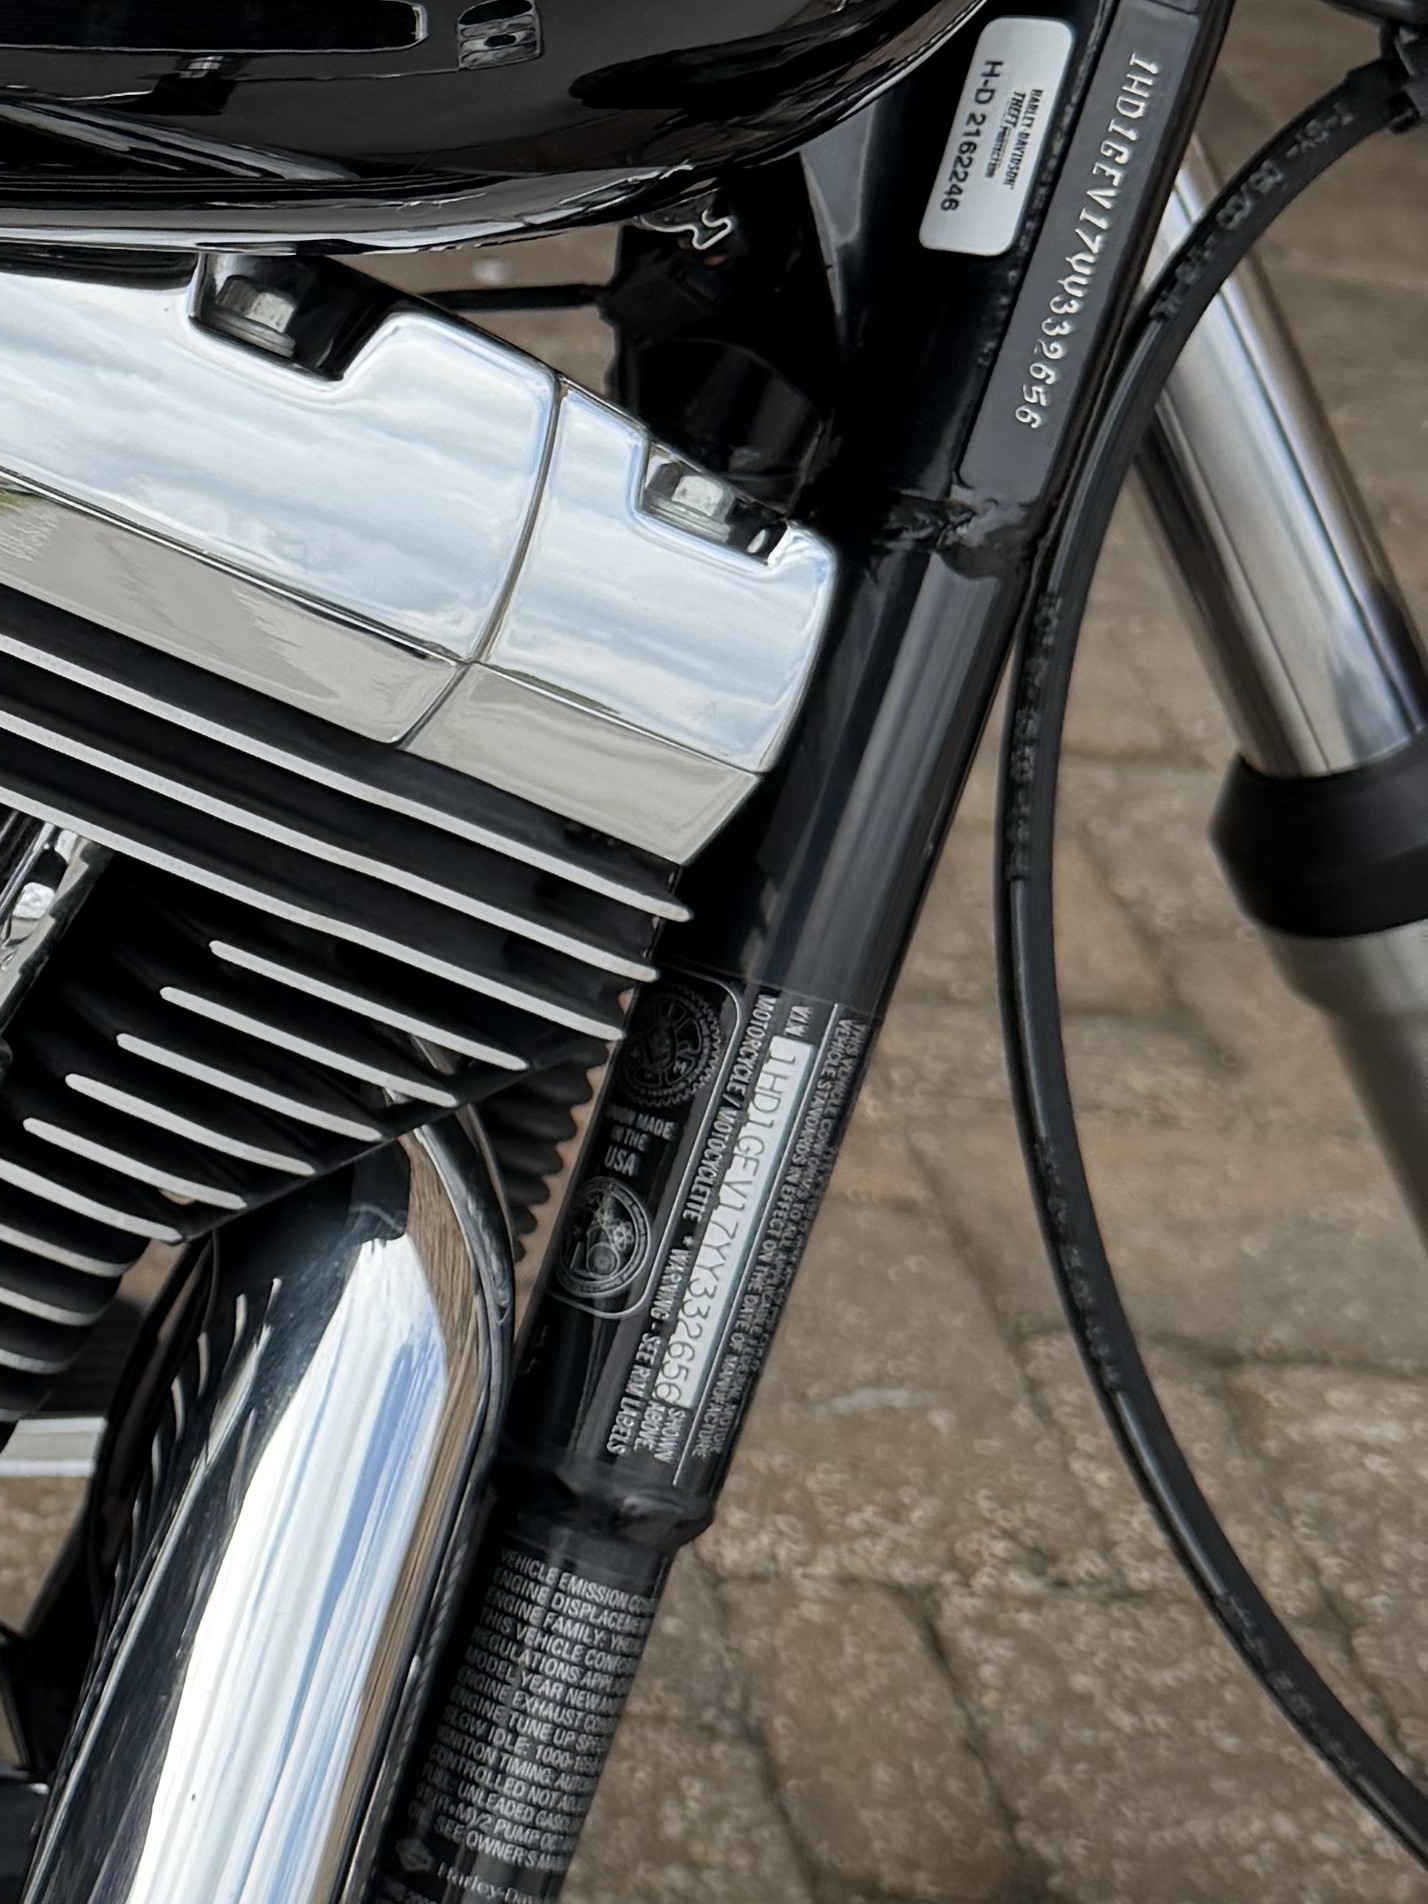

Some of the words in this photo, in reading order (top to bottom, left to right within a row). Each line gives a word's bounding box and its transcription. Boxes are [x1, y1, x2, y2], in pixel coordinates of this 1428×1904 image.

[972, 55, 1003, 108] H-D
[940, 108, 985, 215] 2162246
[784, 1003, 814, 1039] VIN
[728, 991, 778, 1098] MOTORCYCLE
[819, 1016, 854, 1078] VEHICLE
[604, 1145, 640, 1176] USA
[649, 1046, 799, 1406] 1HD1GEV17YY332656
[647, 1245, 693, 1323] WARNING
[746, 1263, 769, 1294] THE
[733, 1293, 759, 1332] DATE
[633, 1330, 663, 1366] SEE
[623, 1363, 653, 1398] RIM
[606, 1395, 638, 1456] LABELS
[486, 1586, 546, 1627] ENGINE
[493, 1566, 554, 1607] ENGINE
[516, 1622, 584, 1662] VEHICLE
[465, 1646, 519, 1686] MODEL
[521, 1669, 567, 1703] YEAR
[509, 1709, 553, 1743] TUNE
[553, 1727, 577, 1747] UP
[512, 1690, 585, 1727] EXHAUST
[429, 1744, 529, 1799] CONTROLLED
[457, 1780, 535, 1825] UNLEADED
[493, 1818, 541, 1846] PUMP
